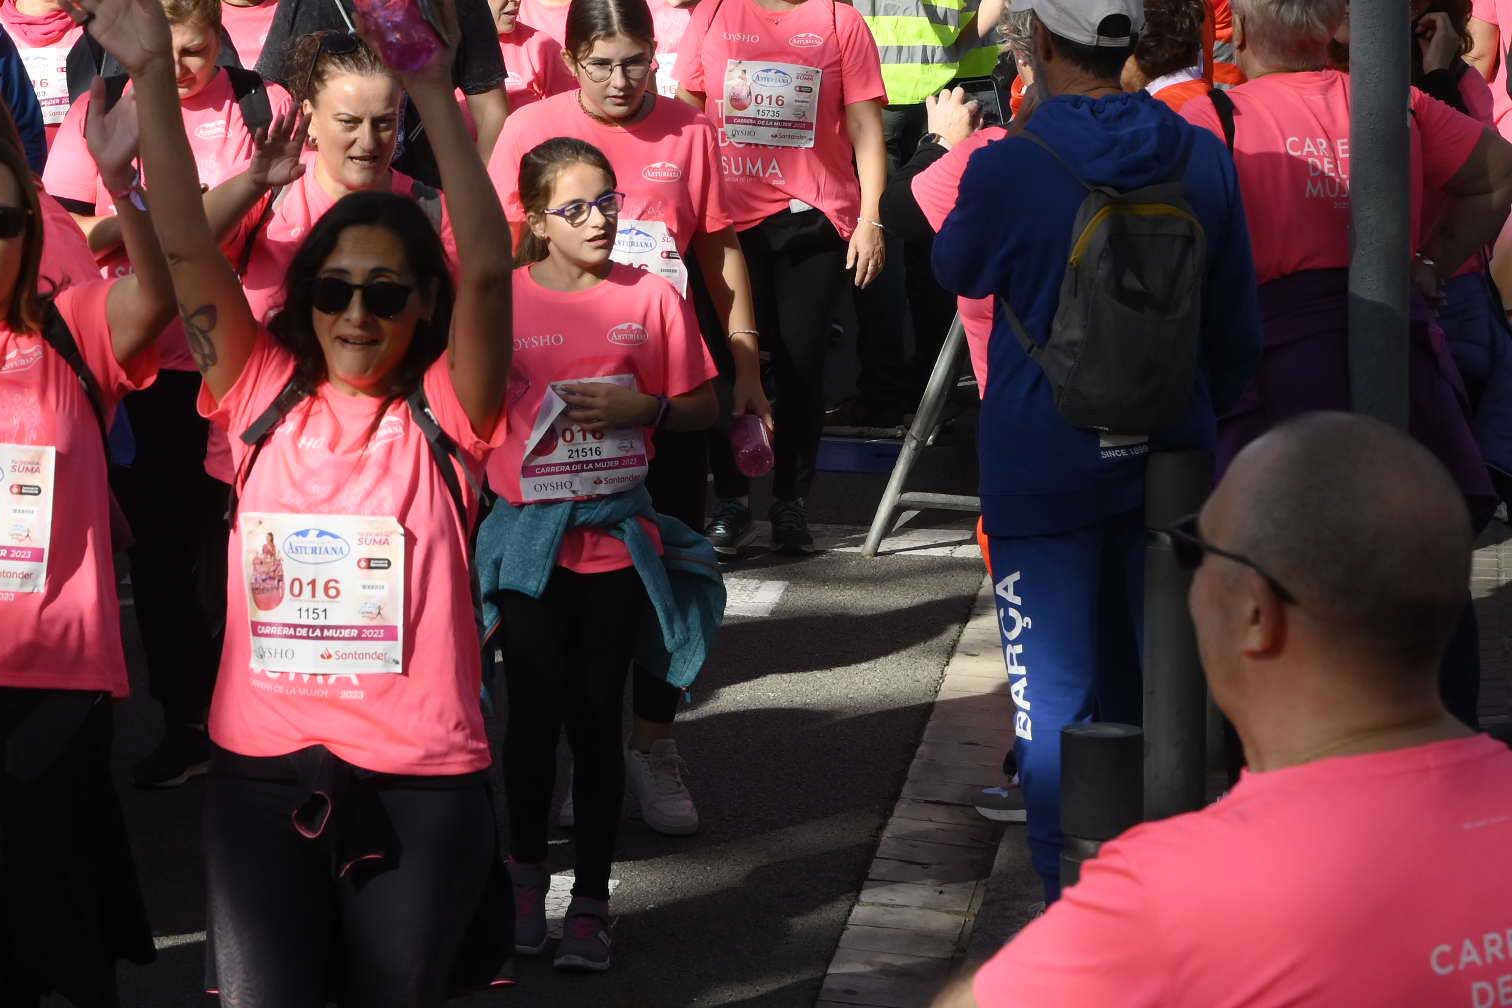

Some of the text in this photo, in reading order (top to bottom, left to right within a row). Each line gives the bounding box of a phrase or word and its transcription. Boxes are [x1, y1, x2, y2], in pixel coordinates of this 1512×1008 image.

[754, 93, 786, 107] 016
[756, 109, 780, 119] 15735
[721, 156, 783, 178] SUMA
[567, 446, 602, 459] 21516
[535, 465, 570, 474] CARRERA
[534, 480, 573, 493] OYSHO
[10, 549, 32, 558] 2023
[288, 541, 345, 556] ASTURIANA
[289, 577, 341, 600] 016
[297, 607, 328, 621] 1151
[257, 625, 384, 638] CARRERA DE LA MUJER 2023
[334, 649, 389, 661] Santander
[995, 570, 1032, 742] BARÇA
